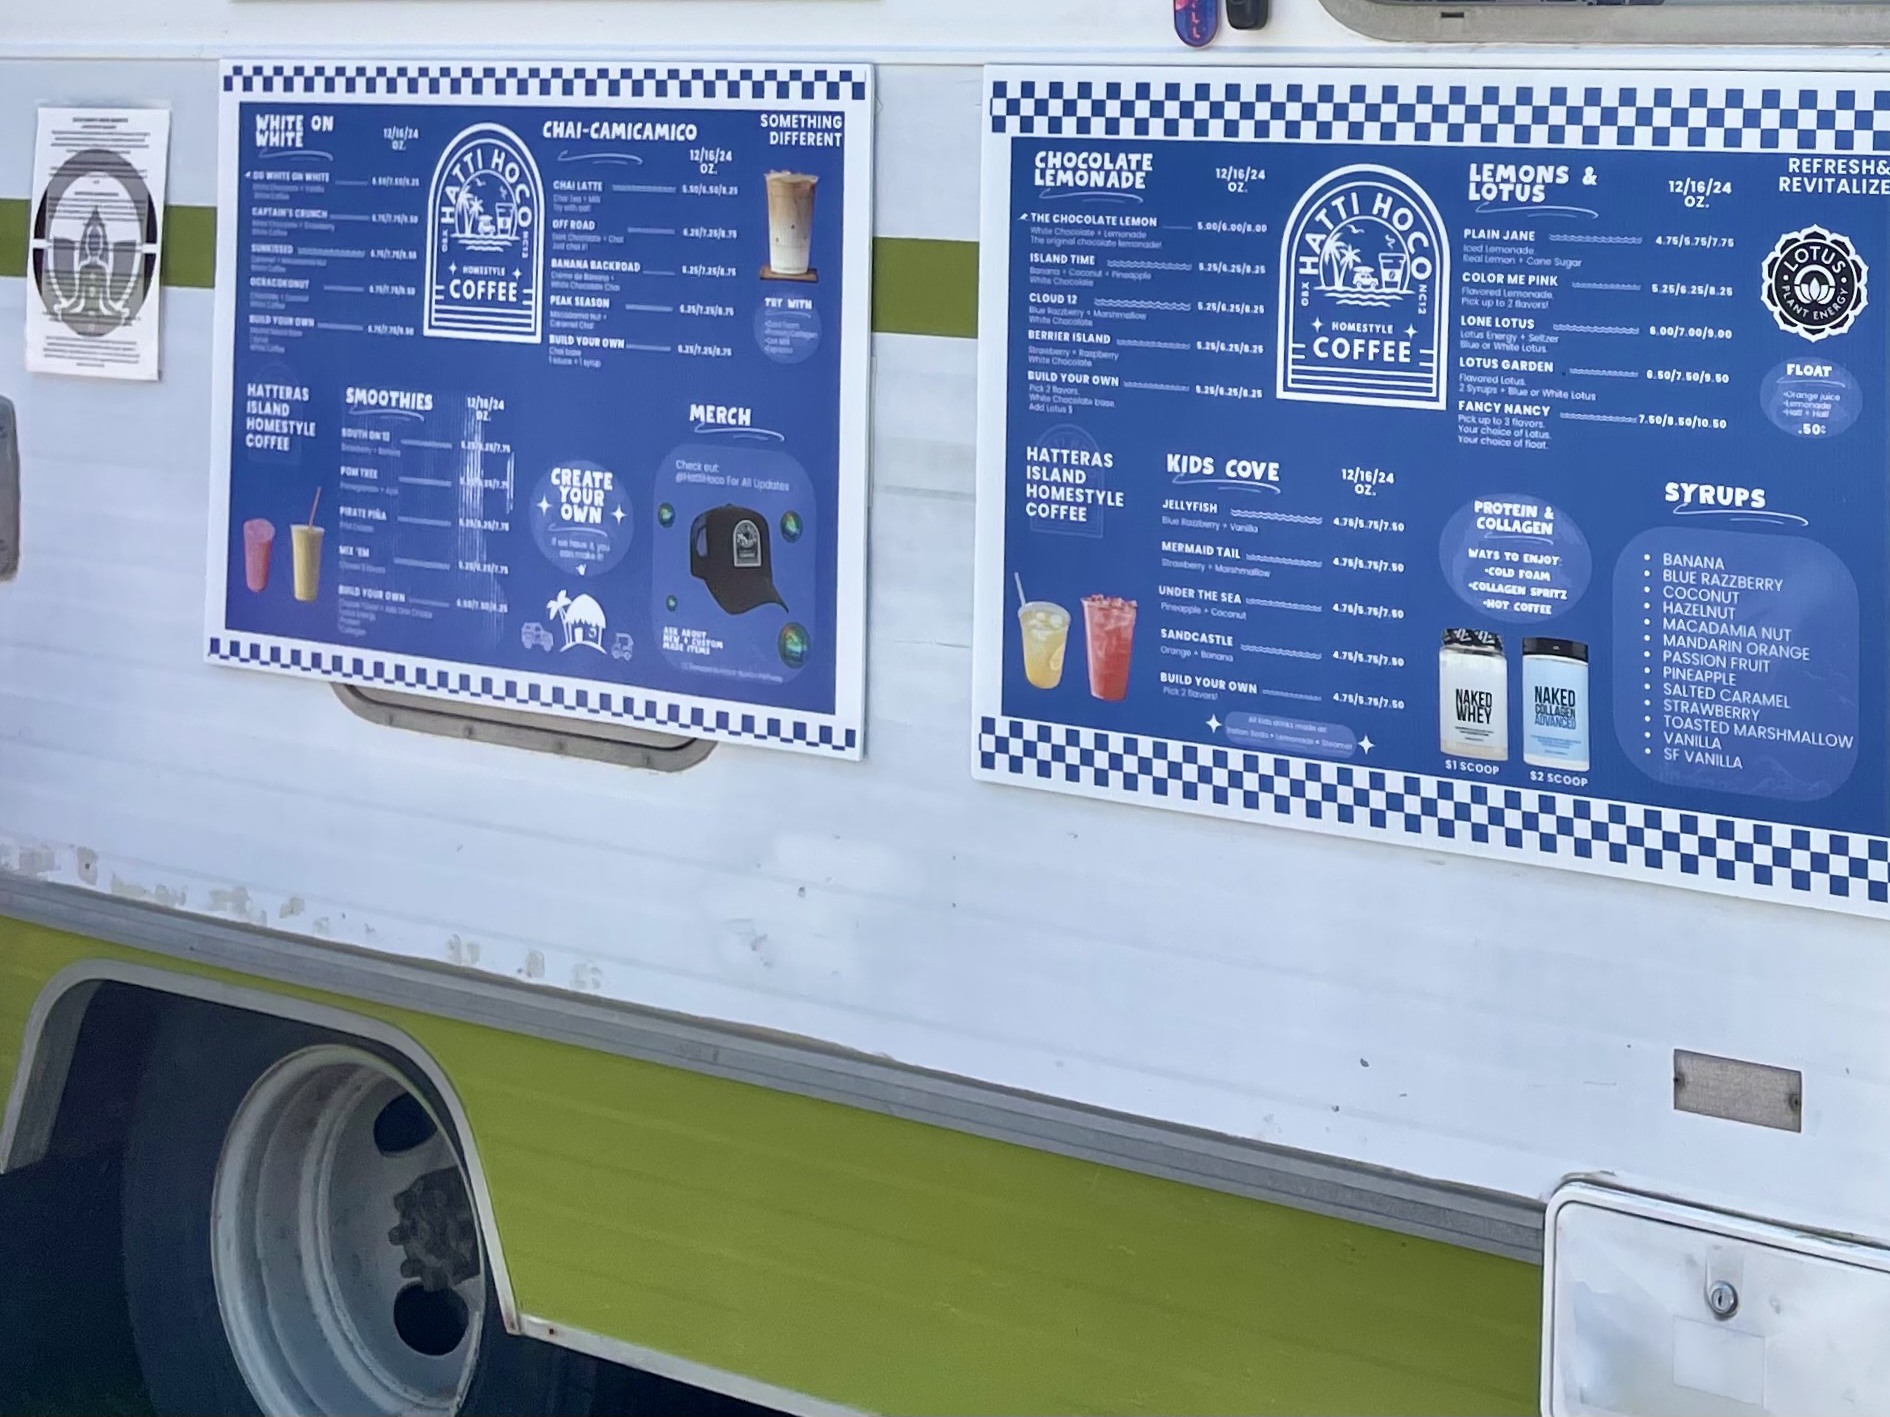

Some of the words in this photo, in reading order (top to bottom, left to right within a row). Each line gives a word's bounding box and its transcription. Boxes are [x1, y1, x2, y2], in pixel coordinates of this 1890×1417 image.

[256, 114, 304, 131] WHITE
[311, 116, 334, 132] ON
[760, 114, 842, 129] SOMETHING
[256, 131, 304, 147] WHITE
[543, 121, 697, 142] CHAI-CAMICAMICO
[770, 132, 842, 147] DIFFERENT
[1034, 151, 1153, 171] CHOCOLATE
[1789, 158, 1890, 175] REFRESH&
[1034, 169, 1146, 190] LEMONADE
[1216, 166, 1266, 181] 12/16/24
[1470, 163, 1569, 184] LEMONS
[1582, 166, 1597, 185] &
[1469, 183, 1546, 202] LOTUS
[1669, 178, 1732, 195] 12/16/24
[1779, 177, 1890, 195] REVITALIZE
[1031, 213, 1050, 222] THE
[1053, 214, 1118, 226] CHOCOLATE
[1120, 216, 1157, 227] LEMON
[1299, 192, 1359, 275] HATTI
[1372, 193, 1432, 280] HOCO
[1464, 229, 1499, 240] PLAIN
[1503, 230, 1535, 241] JANE
[1783, 246, 1846, 273] LOTUS
[1462, 272, 1504, 284] COLOR
[1508, 274, 1525, 286] ME
[1528, 275, 1558, 287] PINK
[1030, 293, 1064, 304] CLOUD
[1068, 295, 1078, 304] 12
[1301, 281, 1309, 306] OBX
[1418, 284, 1427, 315] NC12
[1783, 284, 1809, 319] PLANT
[1813, 286, 1848, 320] ENERGY
[1332, 321, 1394, 334] HOMESTYLE
[1313, 337, 1411, 363] COFFEE
[1787, 363, 1832, 377] FLOAT
[346, 387, 433, 411] SMOOTHIES
[690, 404, 751, 427] MERCH
[1459, 401, 1501, 414] FANCY
[1504, 403, 1551, 417] NANCY
[1026, 446, 1114, 468] HATTERAS
[1026, 466, 1086, 485] ISLAND
[1166, 453, 1215, 475] KIDS
[1225, 458, 1280, 482] COVE
[551, 467, 613, 491] CREATE
[559, 487, 604, 507] YOUR
[1026, 484, 1125, 508] HOMESTYLE
[1665, 482, 1766, 508] SYRUPS
[561, 505, 602, 524] OWN
[1026, 502, 1087, 523] COFFEE
[1162, 499, 1218, 514] JELLYFISH
[1474, 501, 1538, 519] PROTEIN
[1545, 506, 1555, 520] &
[1476, 517, 1554, 536] COLLAGEN
[1663, 553, 1724, 570] BANANA
[1663, 569, 1697, 585] BLUE
[1701, 573, 1783, 592] RAZZBERRY
[1159, 586, 1195, 599] UNDER
[1198, 589, 1218, 601] THE
[1221, 590, 1242, 603] SEA
[1663, 586, 1740, 604] COCONUT
[1663, 601, 1736, 620] HAZELNUT
[1160, 629, 1233, 646] SANDCASTLE
[1663, 617, 1758, 639] MACADAMIA
[1761, 626, 1791, 642] NUT
[1663, 634, 1743, 654] MANDARIN
[1746, 643, 1810, 661] ORANGE
[1663, 650, 1727, 668] PASSION
[1730, 658, 1770, 673] FRUIT
[1663, 667, 1737, 686] PINEAPPLE
[1455, 688, 1492, 708] NAKED
[1534, 686, 1576, 706] NAKED
[1663, 683, 1716, 700] SALTED
[1720, 689, 1791, 708] CARAMEL
[1456, 706, 1492, 725] WHEY
[1534, 704, 1576, 718] COLLAGEN
[1663, 699, 1760, 722] STRAWBERRY
[1534, 716, 1576, 730] ADVANCED
[1664, 715, 1730, 735] TOASTED
[1734, 724, 1853, 749] MARSHMALLOW
[1663, 732, 1722, 750] VANILLA
[1445, 759, 1457, 770] $1
[1460, 761, 1500, 775] SCOOP
[1530, 771, 1544, 782] $2
[1547, 773, 1588, 787] SCOOP
